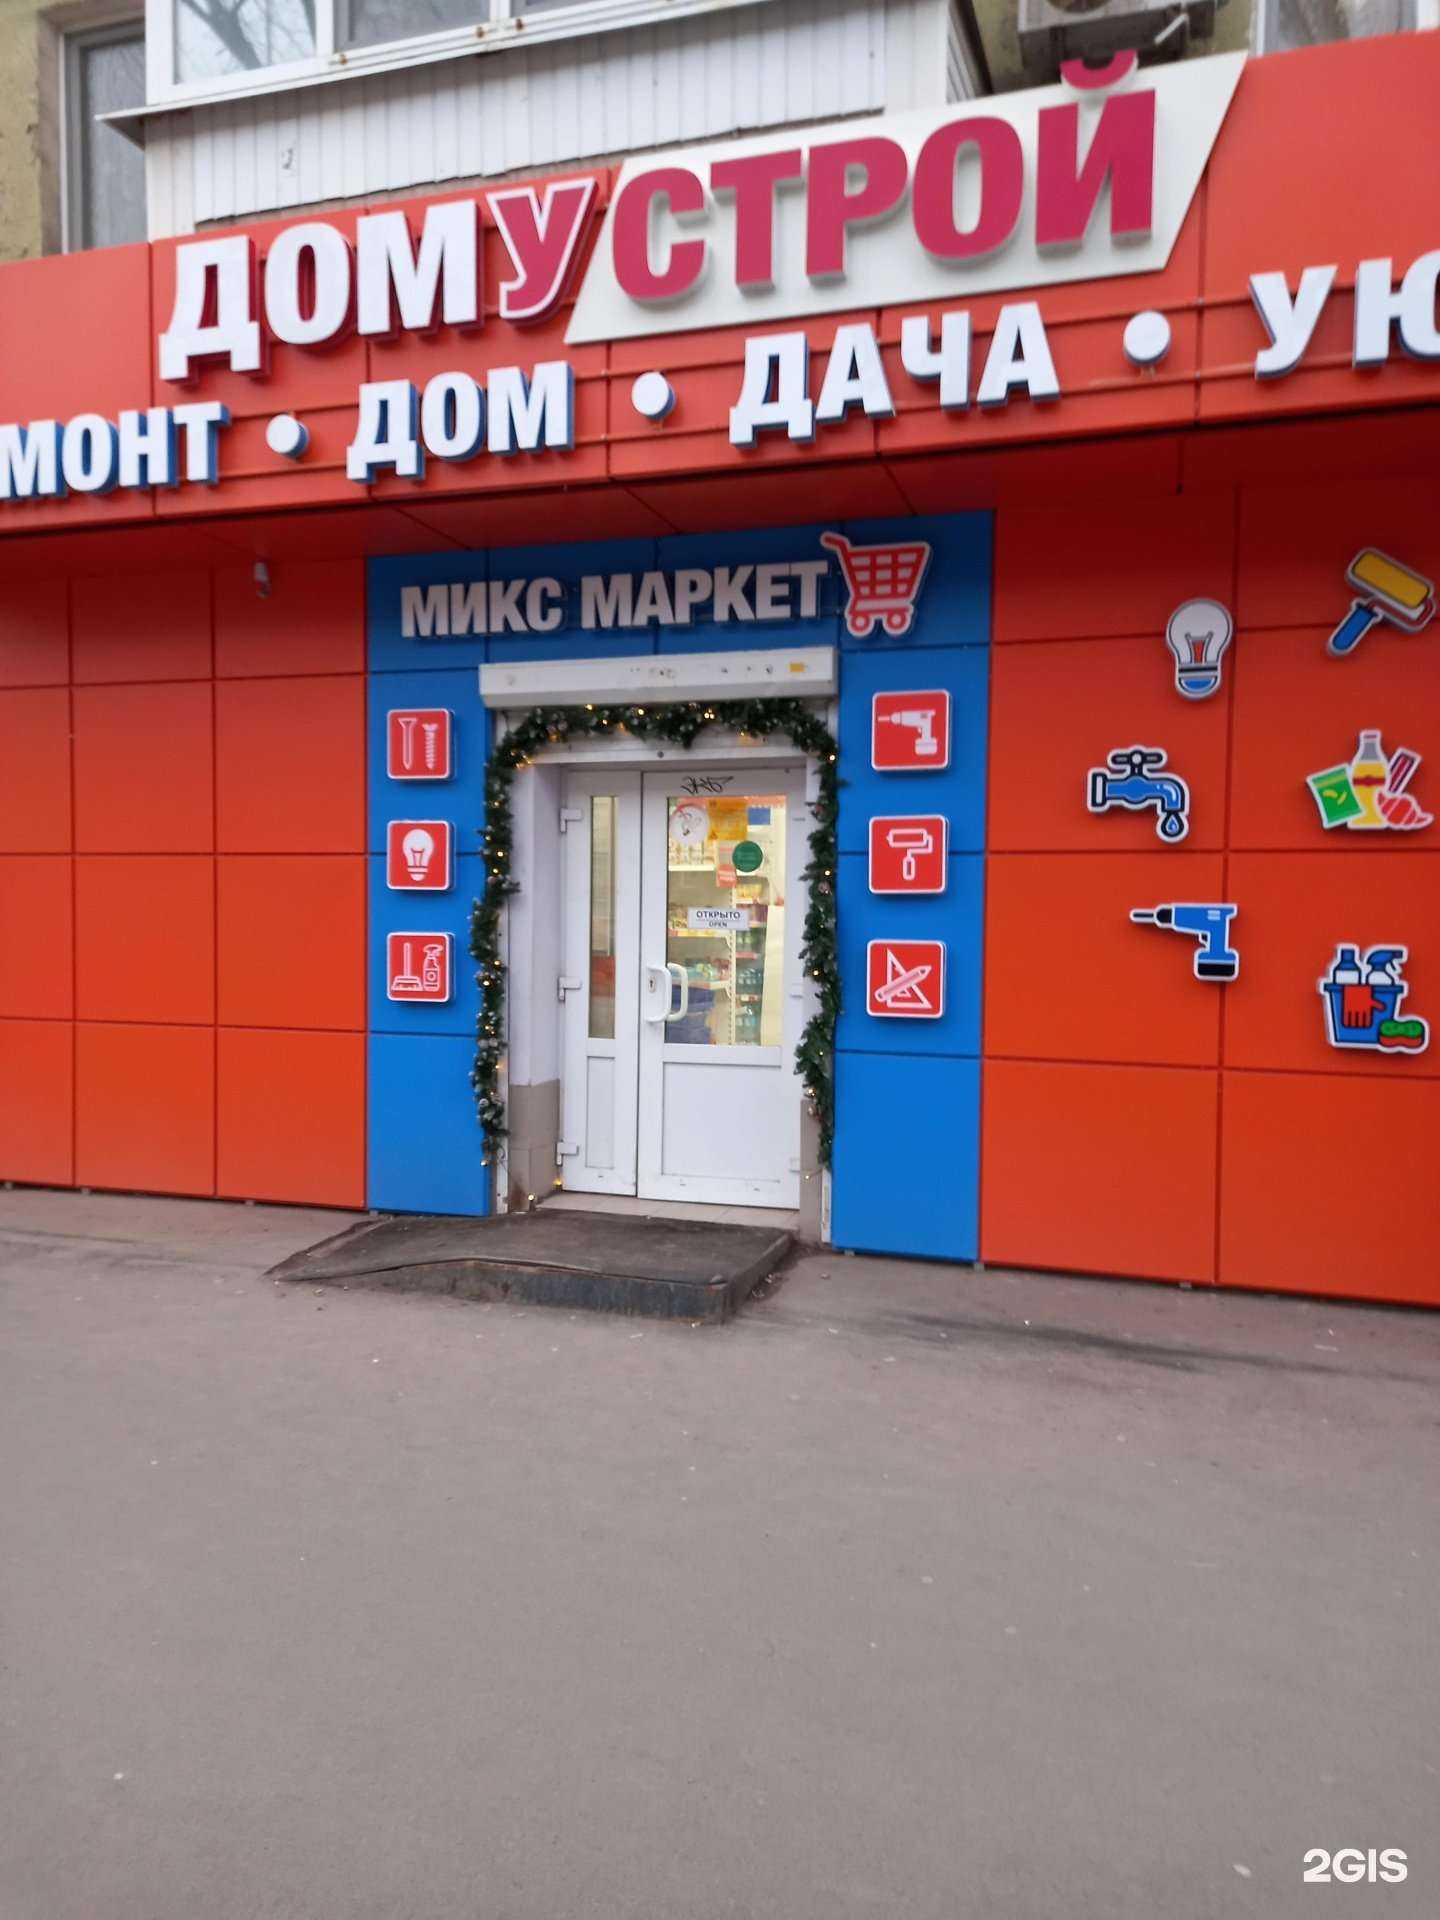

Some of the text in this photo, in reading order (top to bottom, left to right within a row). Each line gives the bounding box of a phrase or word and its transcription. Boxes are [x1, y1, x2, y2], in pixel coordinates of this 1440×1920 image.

[0, 401, 226, 499] МОНТ
[346, 361, 570, 481] ДОМ
[729, 302, 1061, 448] ДАЧА
[401, 560, 828, 638] МИКС МАРКЕТ
[696, 910, 741, 919] ОТКРЫТО
[708, 920, 728, 928] OPEN
